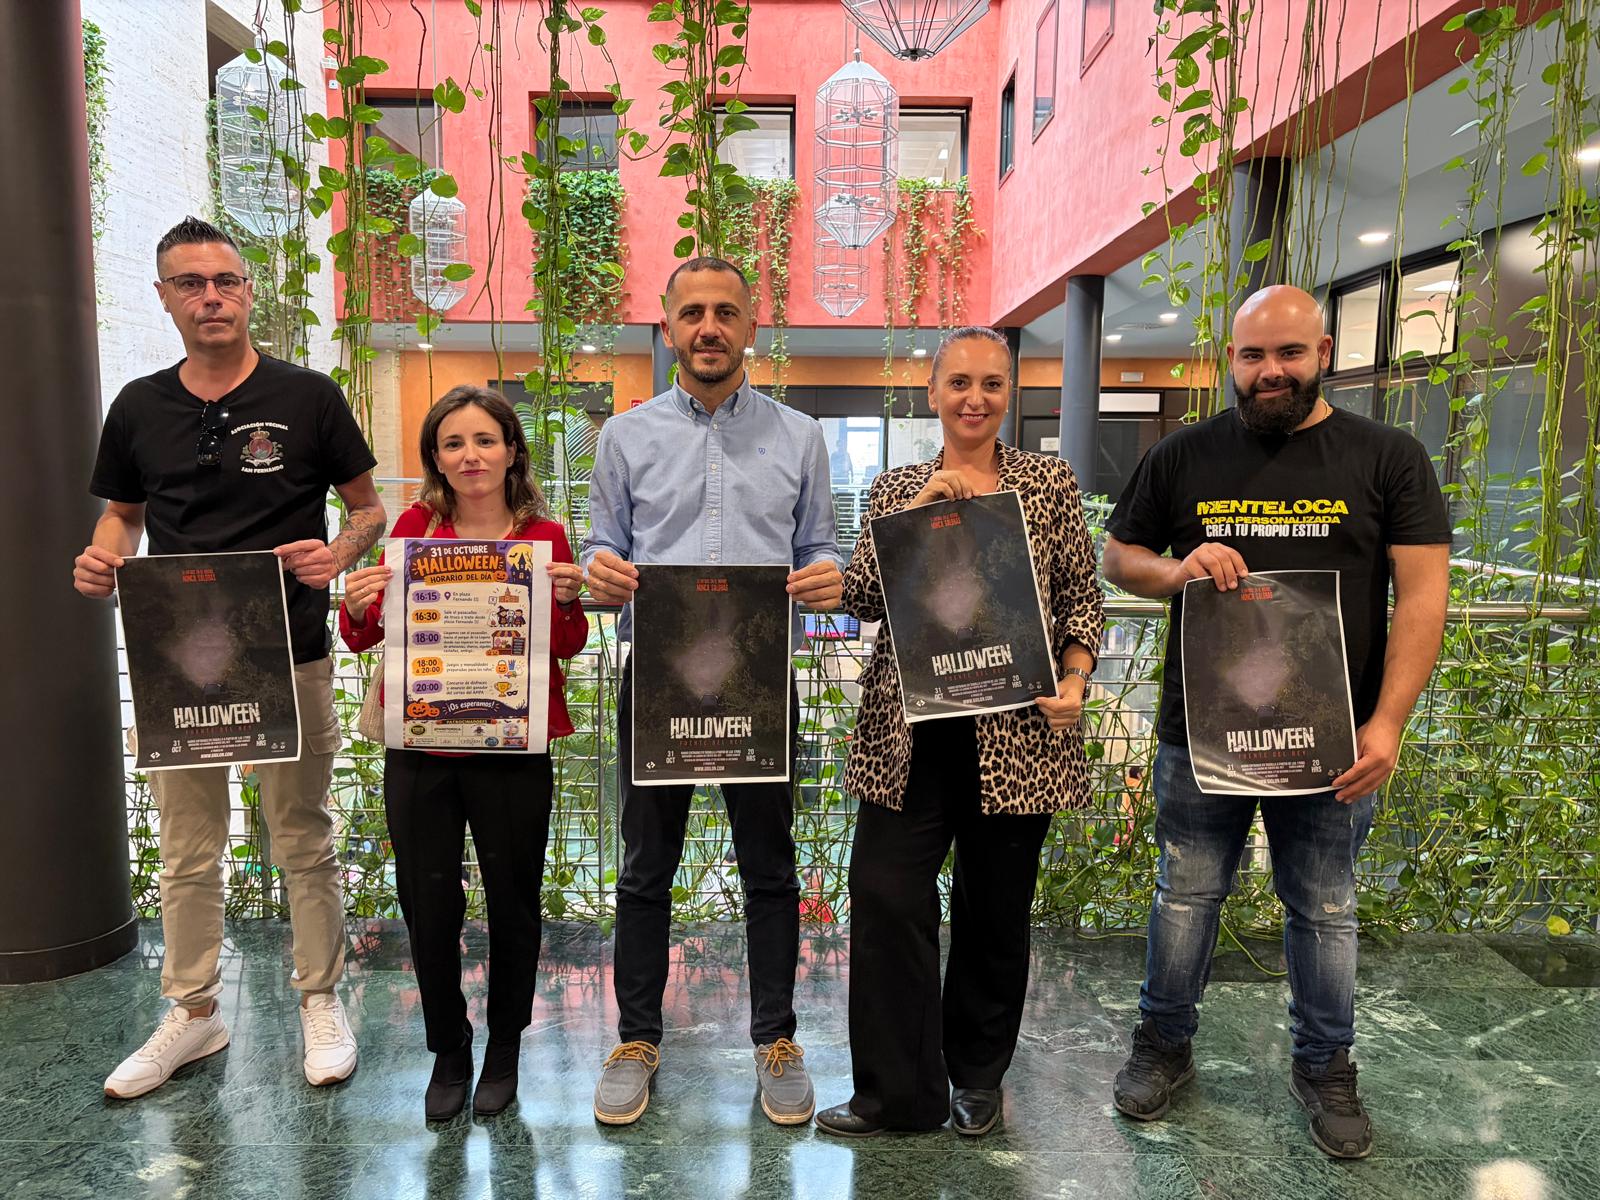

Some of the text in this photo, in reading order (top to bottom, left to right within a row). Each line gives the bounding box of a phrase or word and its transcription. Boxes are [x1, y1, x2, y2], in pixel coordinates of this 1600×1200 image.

[265, 422, 288, 431] VECINAL
[241, 464, 284, 474] SAN FERNANDO
[1196, 499, 1349, 515] MENTELOCA
[1202, 516, 1341, 525] ROPA PERSONALIZADA
[1206, 524, 1330, 537] CREA TU PROPIO ESTILO
[430, 545, 488, 558] 31 DE OCTUBRE
[416, 555, 499, 577] HALLOWEEN
[415, 592, 437, 601] 16:15
[415, 612, 438, 621] 16:30
[415, 632, 439, 643] 18:00
[416, 659, 438, 668] 18:00
[931, 643, 1014, 677] HALLOWEEN
[416, 683, 439, 692] 20:00
[1011, 681, 1022, 689] HRS
[460, 701, 495, 709] esperamos!
[173, 701, 261, 729] HALLOWEEN
[670, 716, 752, 739] HALLOWEEN
[257, 733, 265, 741] 20
[1226, 726, 1315, 753] HALLOWEEN
[173, 739, 181, 747] 31
[171, 746, 183, 754] OCT
[1311, 765, 1322, 773] HRS
